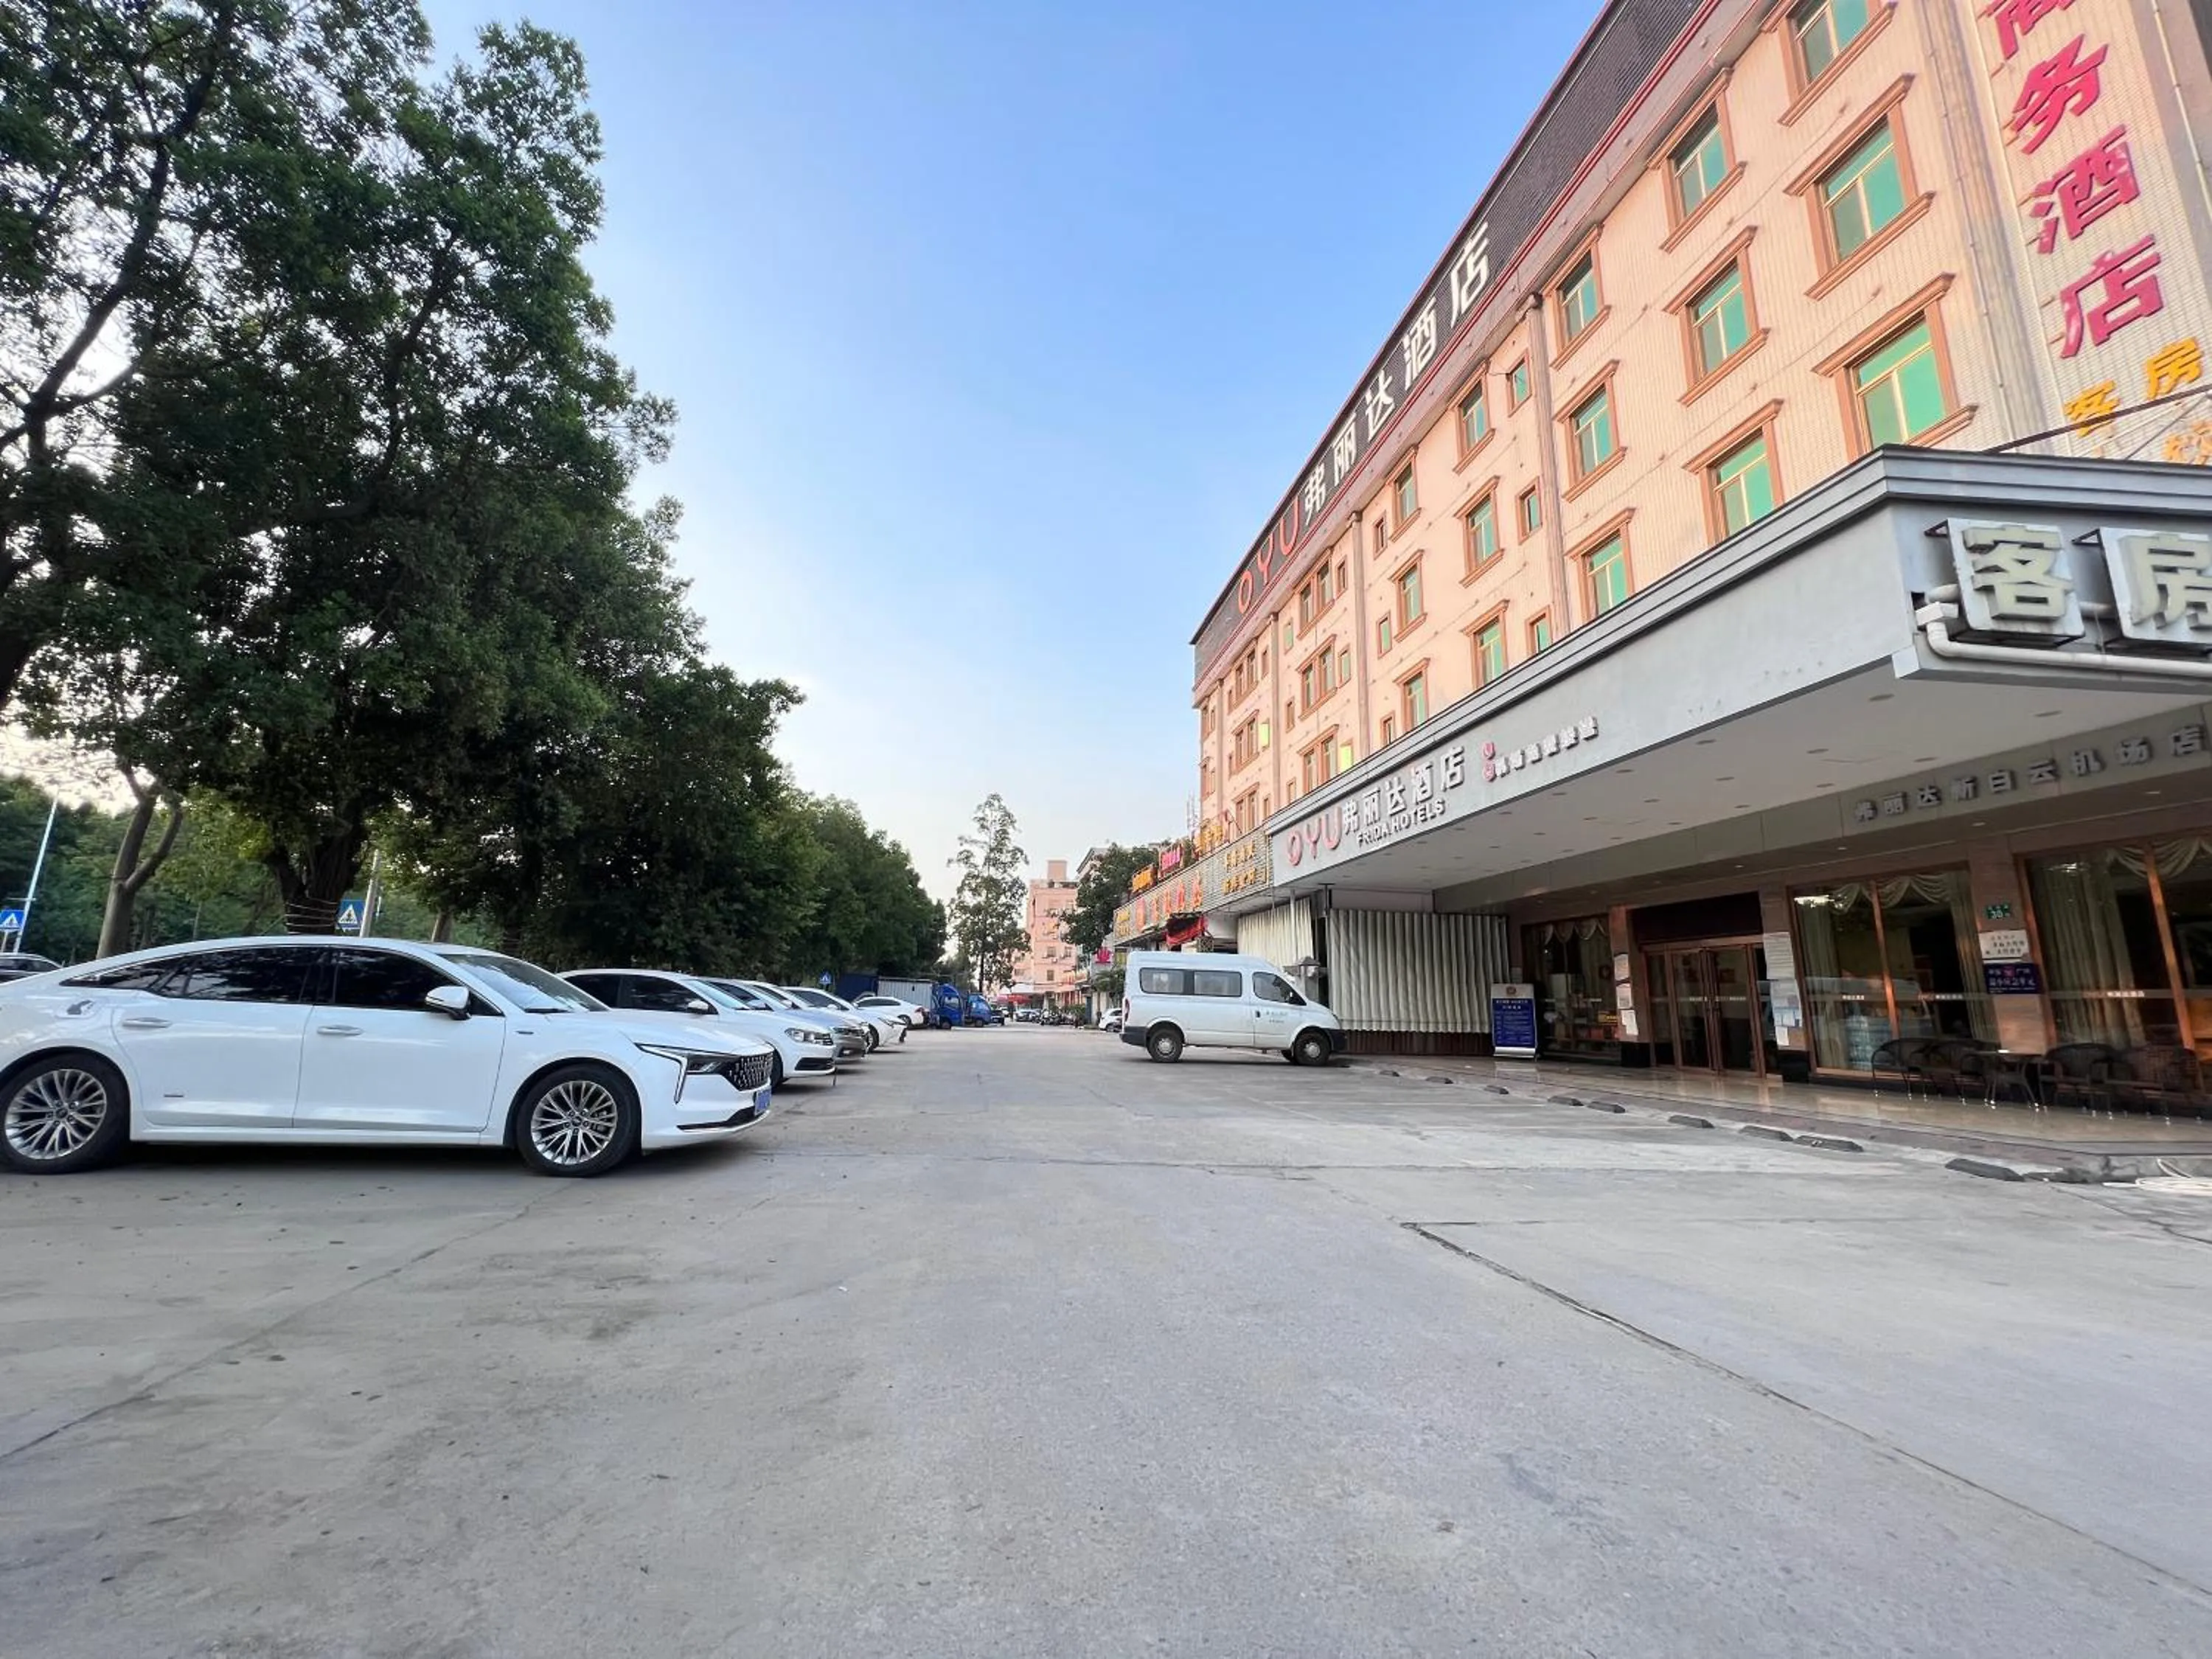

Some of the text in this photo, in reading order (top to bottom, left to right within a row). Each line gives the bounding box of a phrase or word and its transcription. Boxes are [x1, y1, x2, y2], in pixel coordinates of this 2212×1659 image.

[1238, 220, 1489, 614] OYU 弗丽达酒店
[2065, 336, 2204, 432] 客房
[1963, 524, 2212, 630] 客房
[1286, 805, 1342, 866] OYU
[1342, 745, 1466, 836] 弗丽达酒店
[1356, 798, 1447, 847] FRIDA HOTELS
[1853, 723, 2206, 823] 弗丽达新白云机场店
